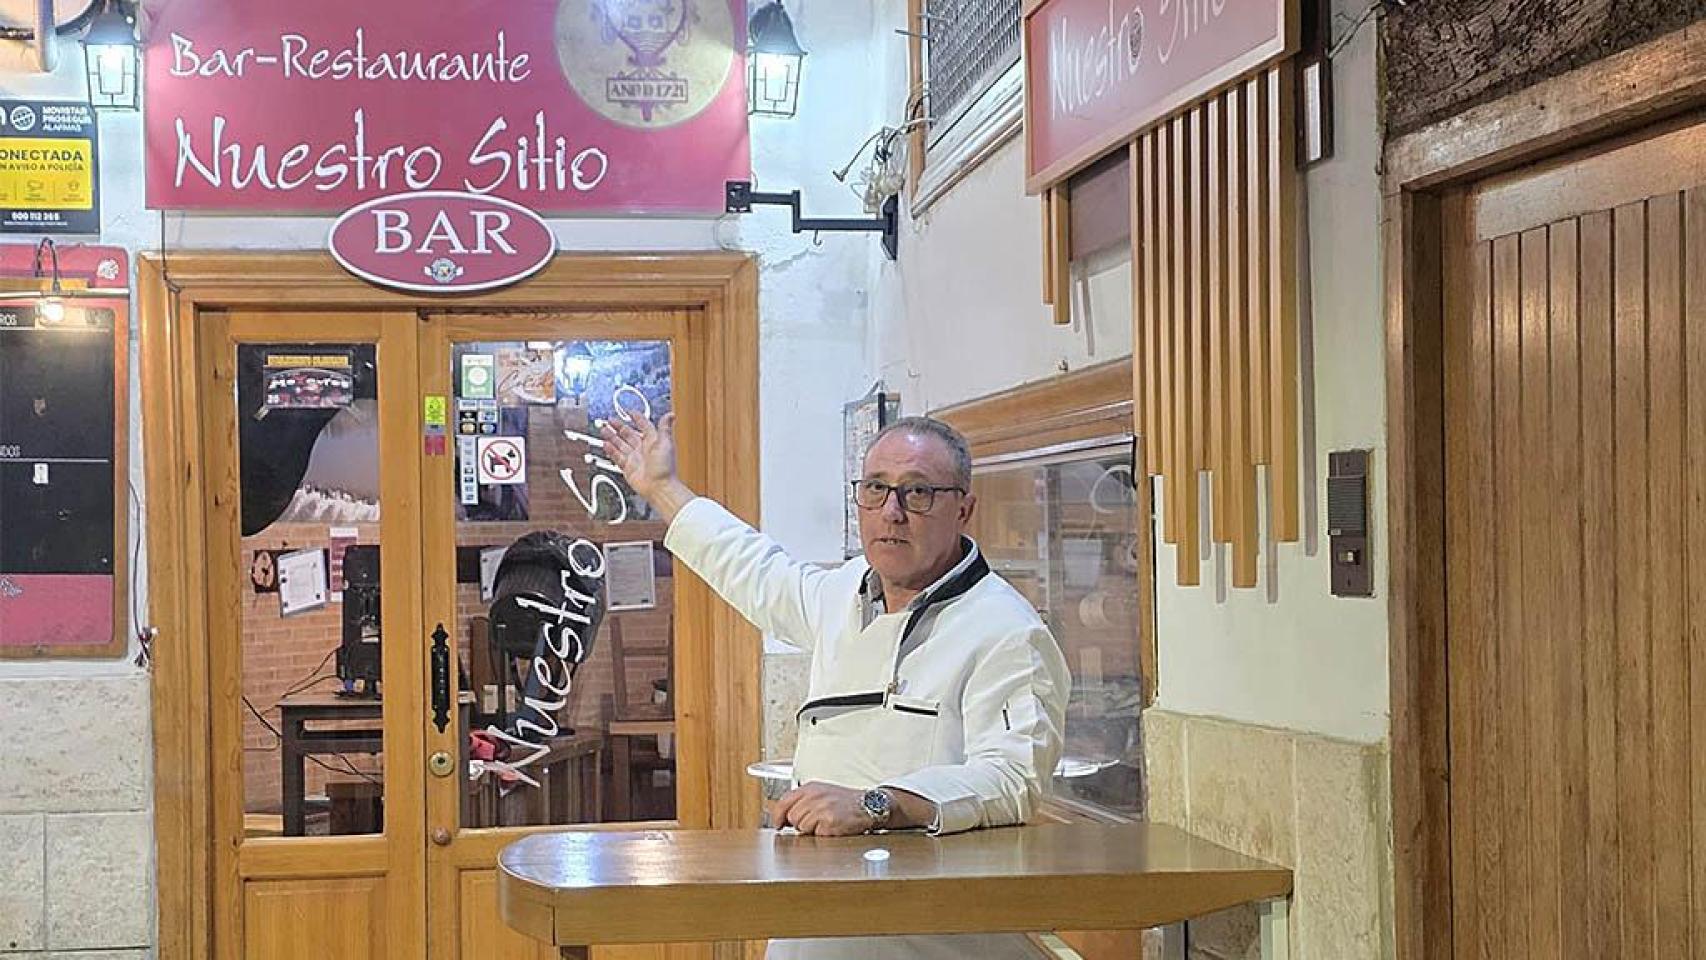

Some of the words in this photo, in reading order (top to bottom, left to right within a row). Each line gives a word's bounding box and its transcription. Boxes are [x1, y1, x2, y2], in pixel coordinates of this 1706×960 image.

[169, 27, 532, 82] Bar-Restaurante
[1050, 0, 1145, 121] Nuestro
[174, 107, 443, 190] Nuestro
[463, 109, 609, 194] Sitio
[370, 209, 517, 255] BAR
[472, 538, 606, 790] Nuestro
